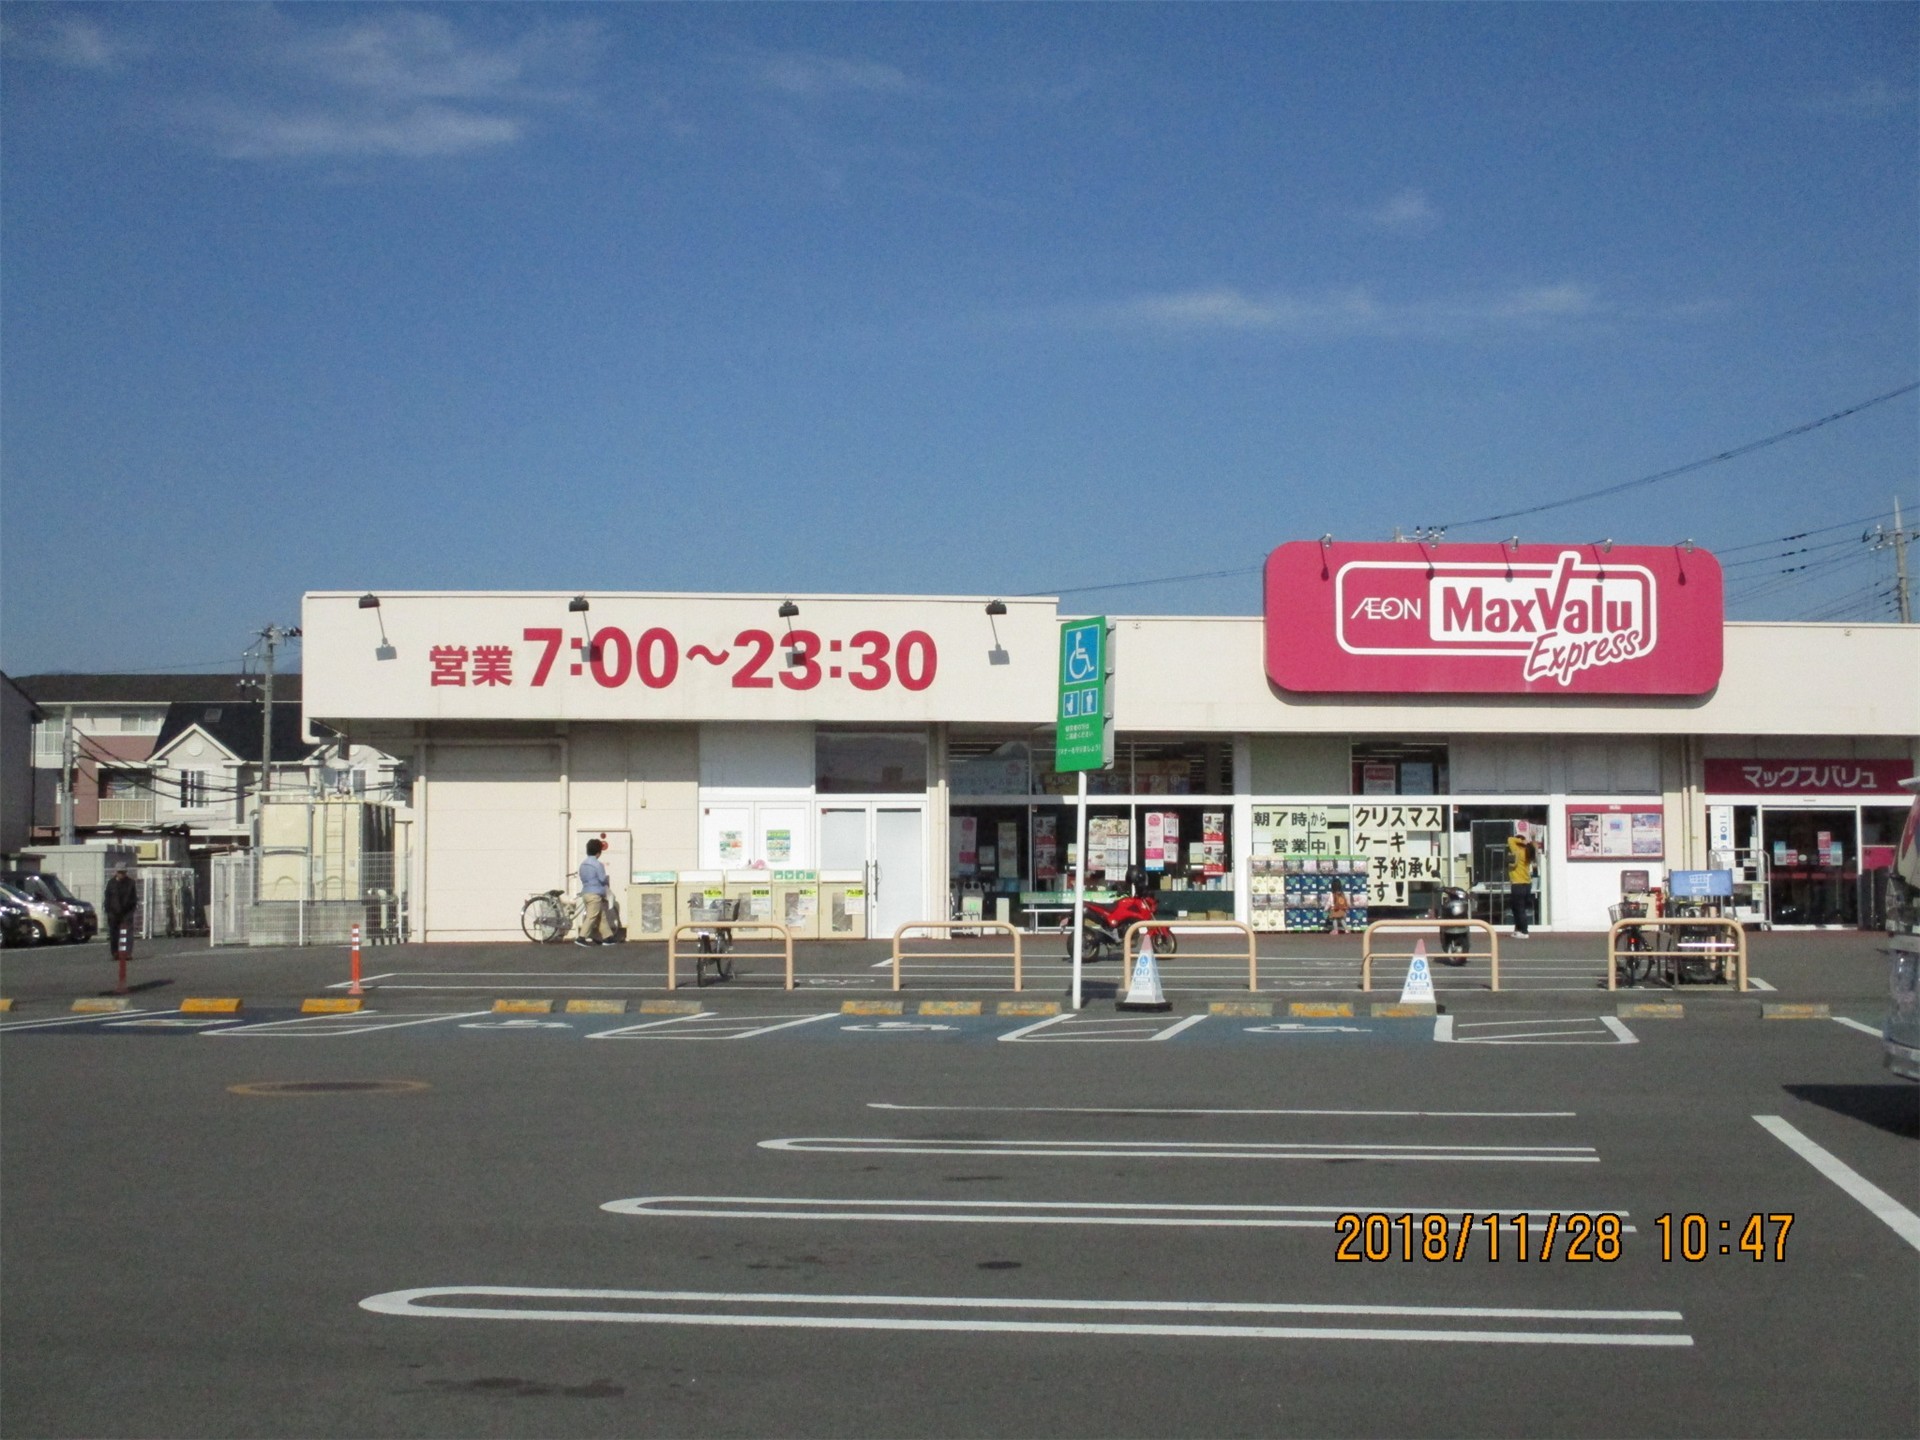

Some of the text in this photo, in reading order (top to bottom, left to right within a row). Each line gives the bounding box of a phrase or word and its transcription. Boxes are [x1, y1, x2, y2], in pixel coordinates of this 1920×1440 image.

[1442, 557, 1633, 634] MaxValu
[431, 646, 511, 686] 営業
[1528, 629, 1641, 681] Express
[1741, 764, 1878, 789] マックスバリュ
[1355, 806, 1442, 828] クリスマス
[1355, 832, 1406, 853] ケーキ
[1366, 855, 1441, 880] 予約承り
